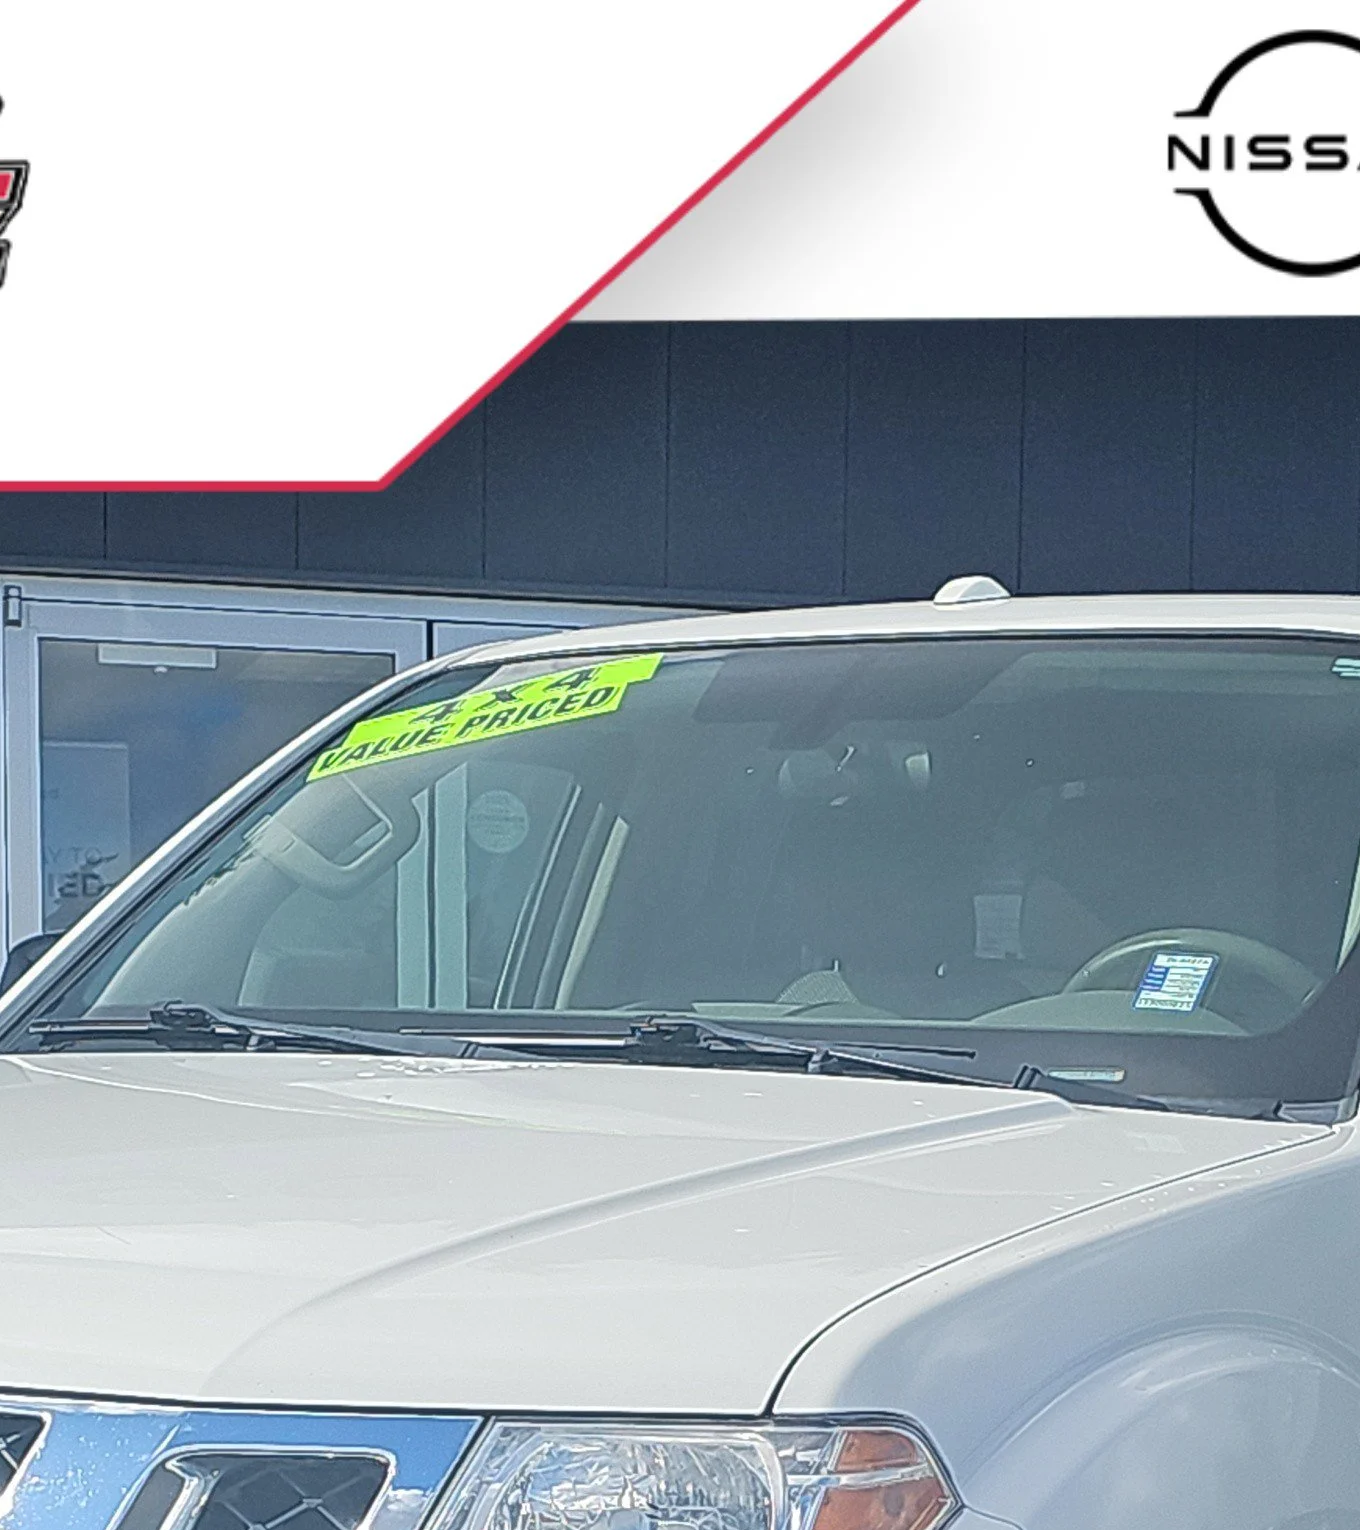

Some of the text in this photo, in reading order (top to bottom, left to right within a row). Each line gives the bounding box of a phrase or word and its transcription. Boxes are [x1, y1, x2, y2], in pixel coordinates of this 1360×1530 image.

[318, 687, 619, 772] VALUE PRICED
[410, 701, 464, 726] 4
[544, 667, 600, 692] 4
